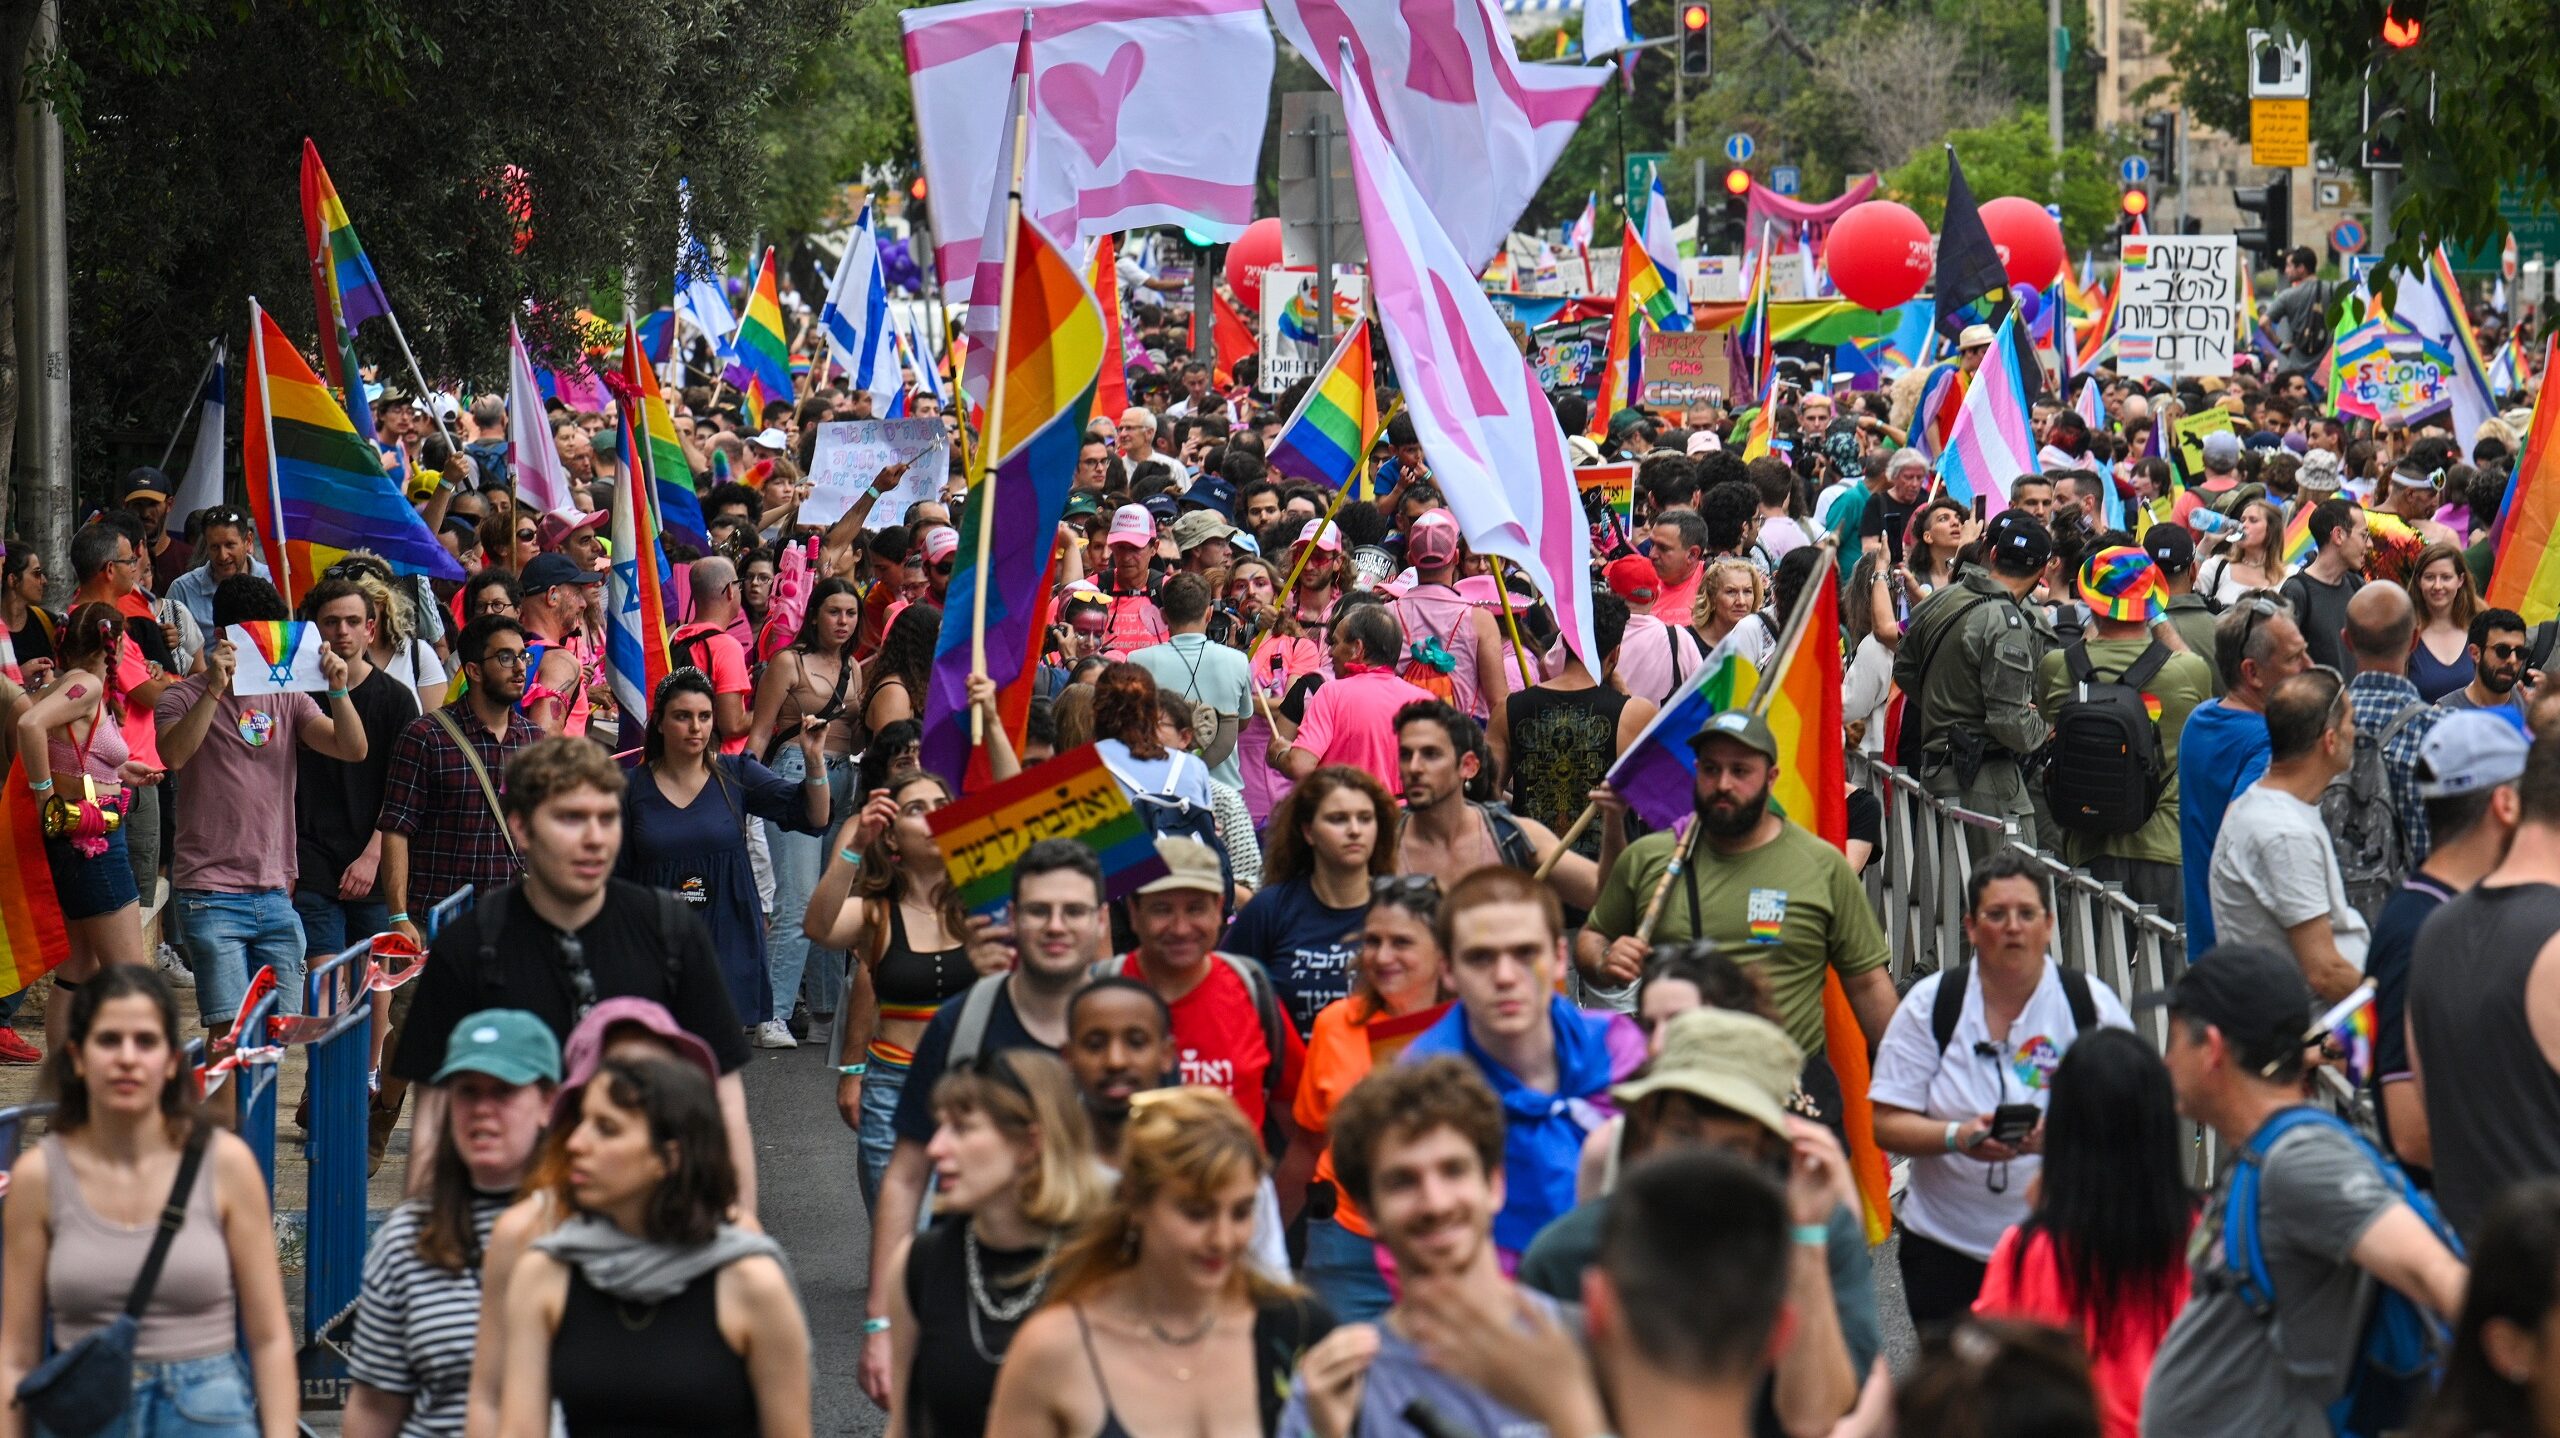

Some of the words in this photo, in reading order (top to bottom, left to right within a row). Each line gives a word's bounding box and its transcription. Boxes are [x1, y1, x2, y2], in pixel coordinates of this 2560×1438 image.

[2147, 245, 2230, 271] זכויות
[2119, 304, 2184, 330] זכויות
[2186, 305, 2230, 331] הם
[1649, 334, 1707, 358] FUCK
[2155, 334, 2226, 361] אדם
[1668, 360, 1704, 377] the
[1024, 786, 1119, 843] ואהבת
[951, 813, 1020, 877] לרעך
